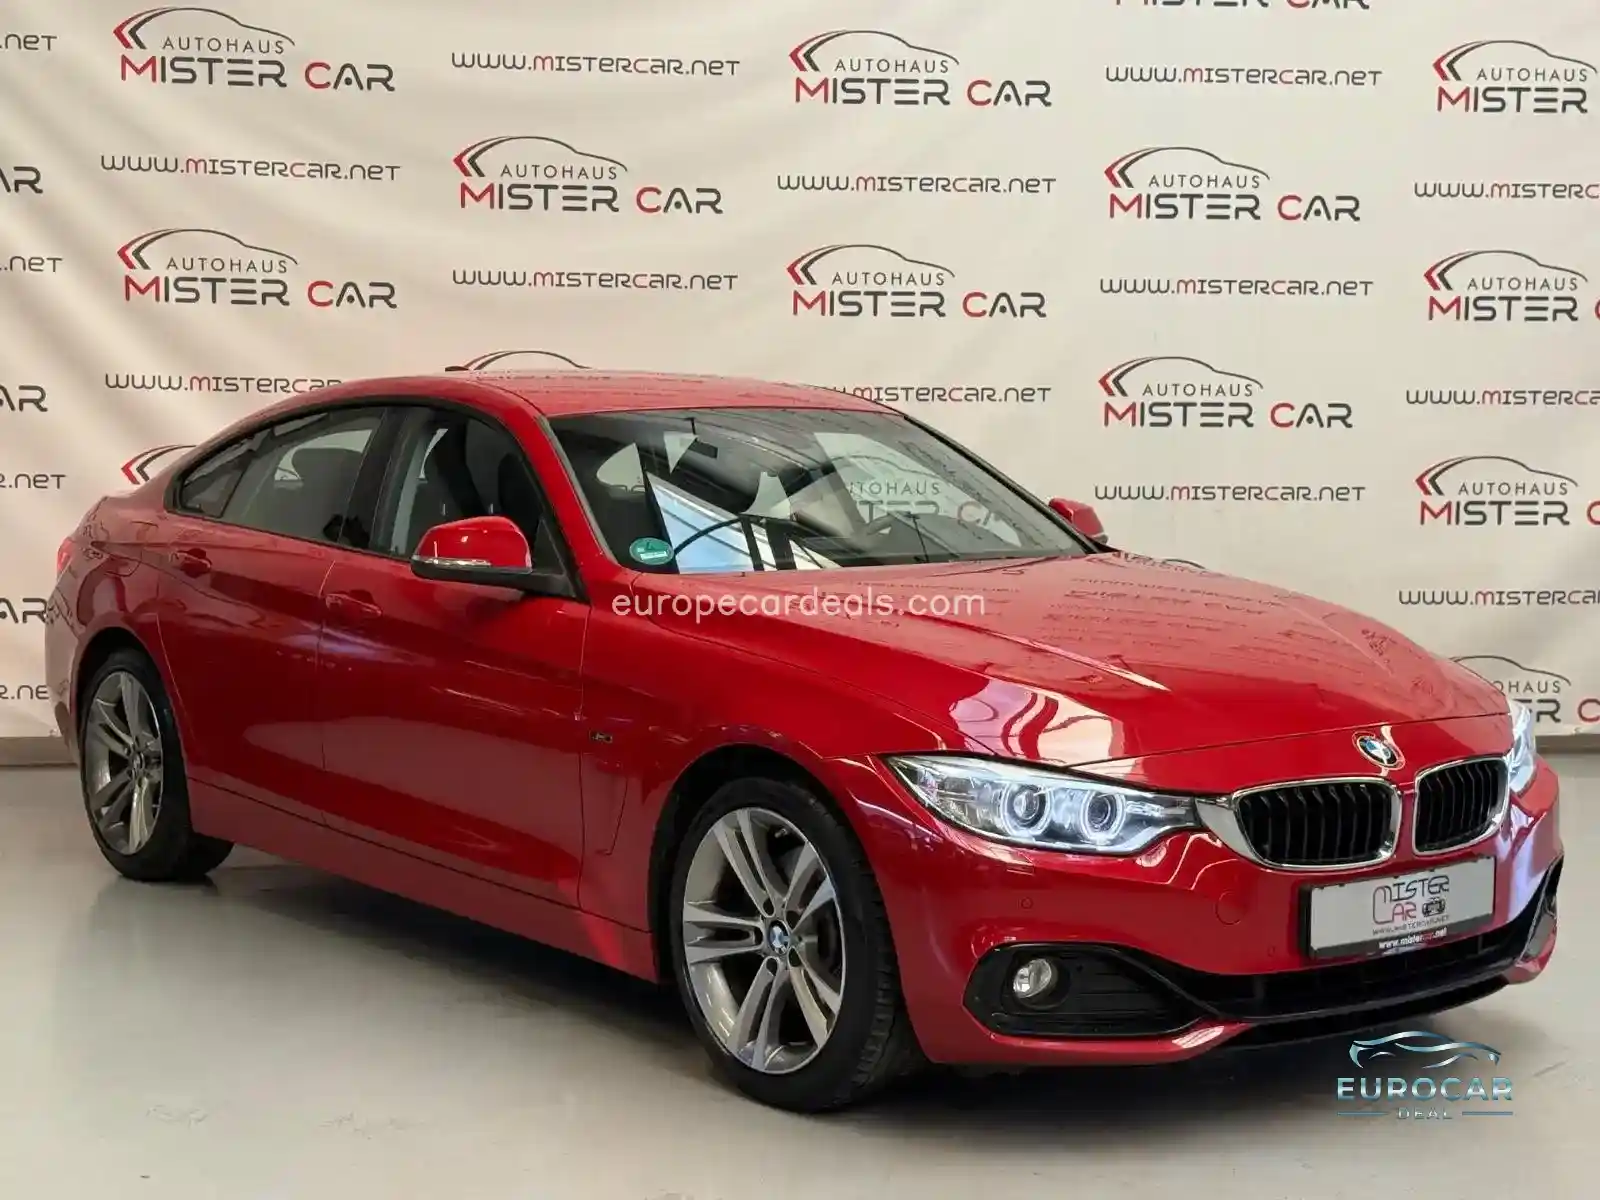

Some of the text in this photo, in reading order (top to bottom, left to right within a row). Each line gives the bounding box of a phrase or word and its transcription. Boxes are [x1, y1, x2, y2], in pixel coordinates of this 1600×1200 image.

[162, 37, 284, 54] AUTOHAUS
[121, 54, 395, 92] MISTER CAR
[834, 59, 949, 74] AUTOHAUS
[1476, 67, 1588, 83] AUTOHAUS
[795, 77, 1052, 107] MISTER CAR
[1437, 86, 1588, 114] MISTER
[500, 164, 617, 180] AUTOHAUS
[1149, 175, 1260, 190] AUTOHAUS
[461, 182, 723, 214] MISTER CAR
[1110, 193, 1360, 221] MISTER CAR
[166, 257, 288, 274] AUTOHAUS
[832, 272, 945, 286] AUTOHAUS
[1467, 277, 1578, 292] AUTOHAUS
[125, 275, 397, 309] MISTER CAR
[793, 290, 1047, 318] MISTER CAR
[1429, 296, 1578, 322] MISTER
[1142, 383, 1253, 398] AUTOHAUS
[1104, 402, 1353, 428] MISTER CAR
[850, 482, 941, 496] TOHAUS
[1457, 482, 1568, 496] AUTOHAUS
[1420, 500, 1570, 526] MISTER
[1399, 590, 1600, 605] www.misterca
